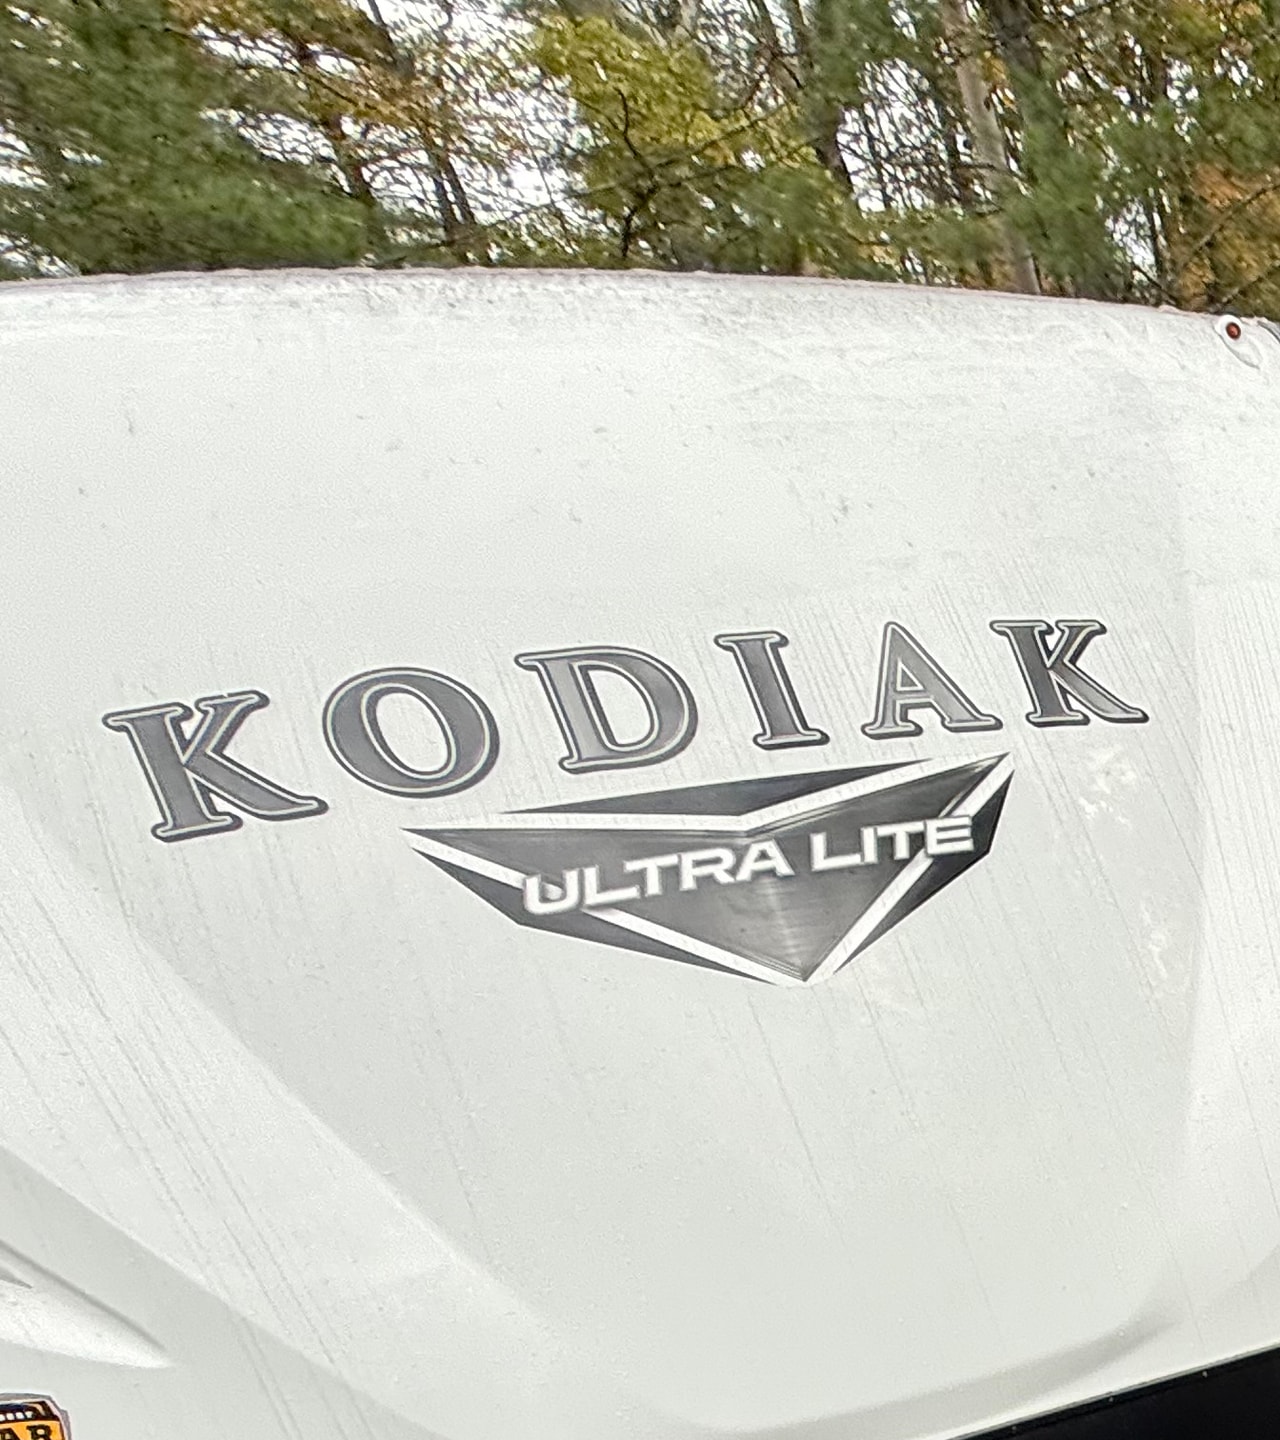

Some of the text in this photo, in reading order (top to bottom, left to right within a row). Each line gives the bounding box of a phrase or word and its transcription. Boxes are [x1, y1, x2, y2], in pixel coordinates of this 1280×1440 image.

[102, 620, 1149, 842] KODIAK
[523, 814, 975, 915] ULTRA LITE
